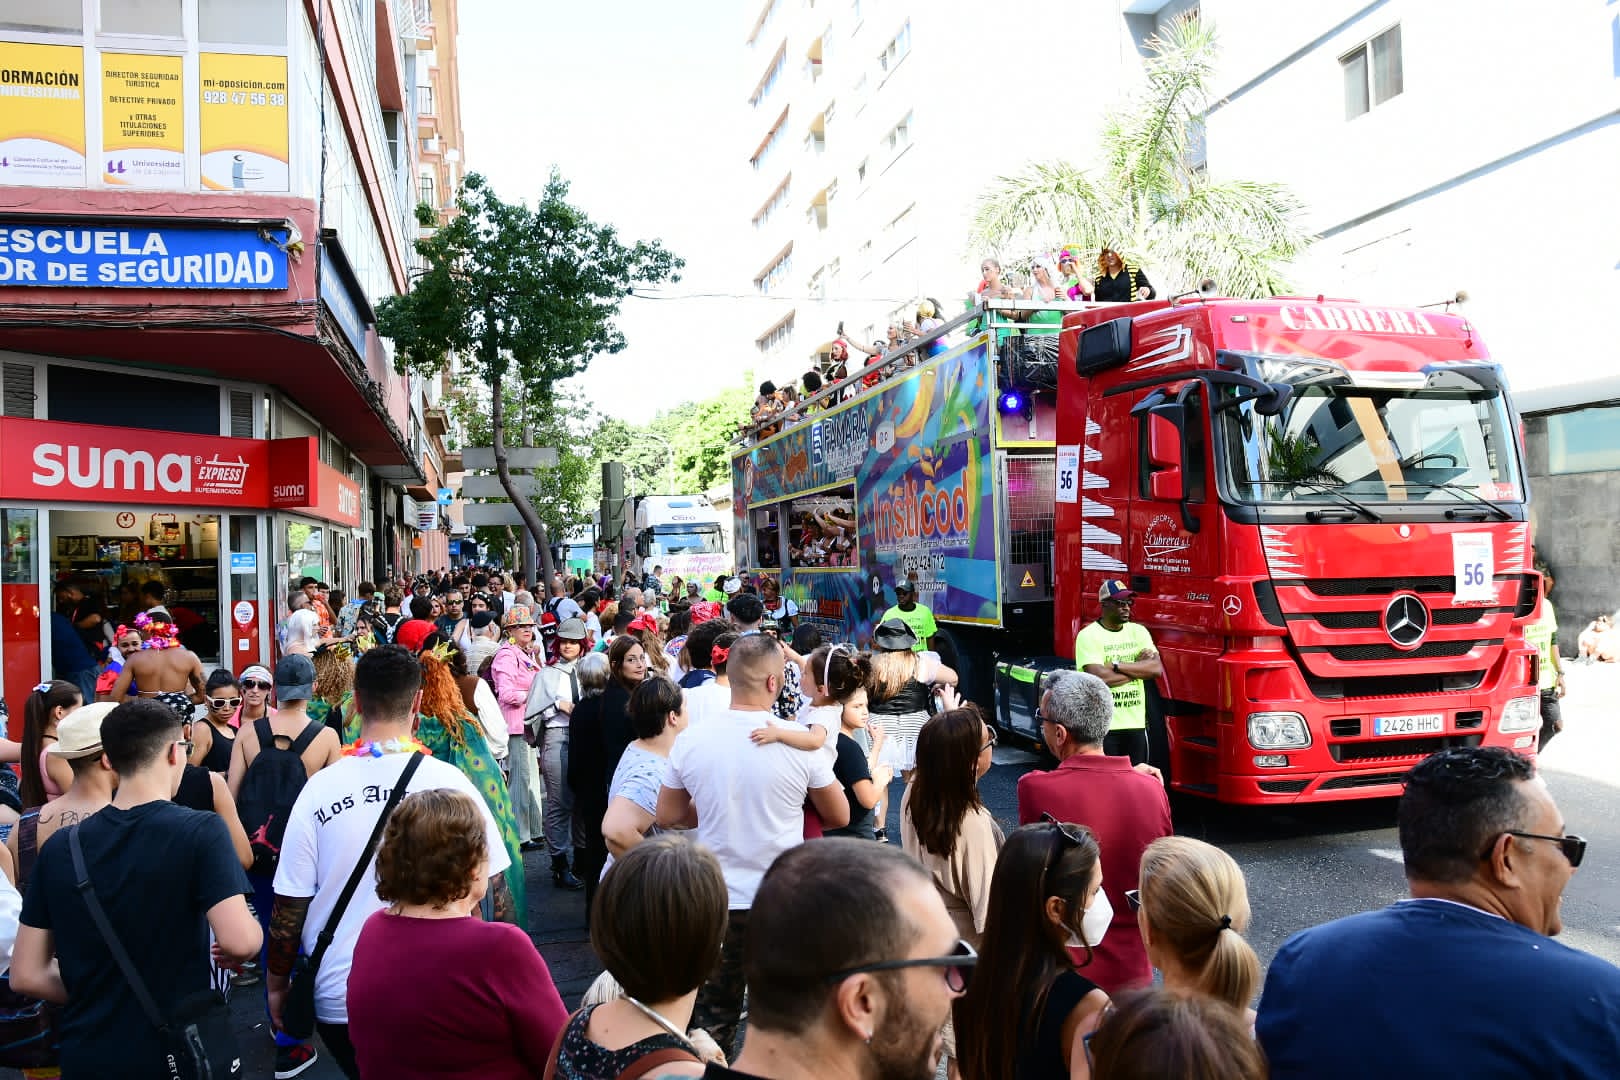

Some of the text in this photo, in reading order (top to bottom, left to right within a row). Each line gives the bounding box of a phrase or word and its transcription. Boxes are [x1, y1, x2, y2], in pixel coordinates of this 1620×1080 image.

[105, 70, 179, 81] DIRECTOR SEGURIDAD
[203, 79, 285, 91] mi-oposicion.com
[109, 95, 176, 106] DETECTIVE PRIVADO
[203, 90, 228, 105] 928
[231, 91, 247, 106] 47
[135, 113, 157, 121] OTRAS
[120, 121, 167, 130] TITULACIONES
[122, 129, 165, 138] SUPERIORES
[47, 262, 89, 282] DE
[98, 251, 275, 284] SEGURIDAD
[1279, 305, 1437, 336] CABRERA
[824, 407, 868, 455] FAMARA
[198, 466, 242, 482] EXPRESS
[1060, 470, 1073, 490] 56
[1148, 533, 1180, 547] Cabrera
[1463, 562, 1485, 586] 56
[1383, 716, 1440, 733] 2426 HHC
[313, 793, 355, 827] Los
[167, 1053, 178, 1075] GET
